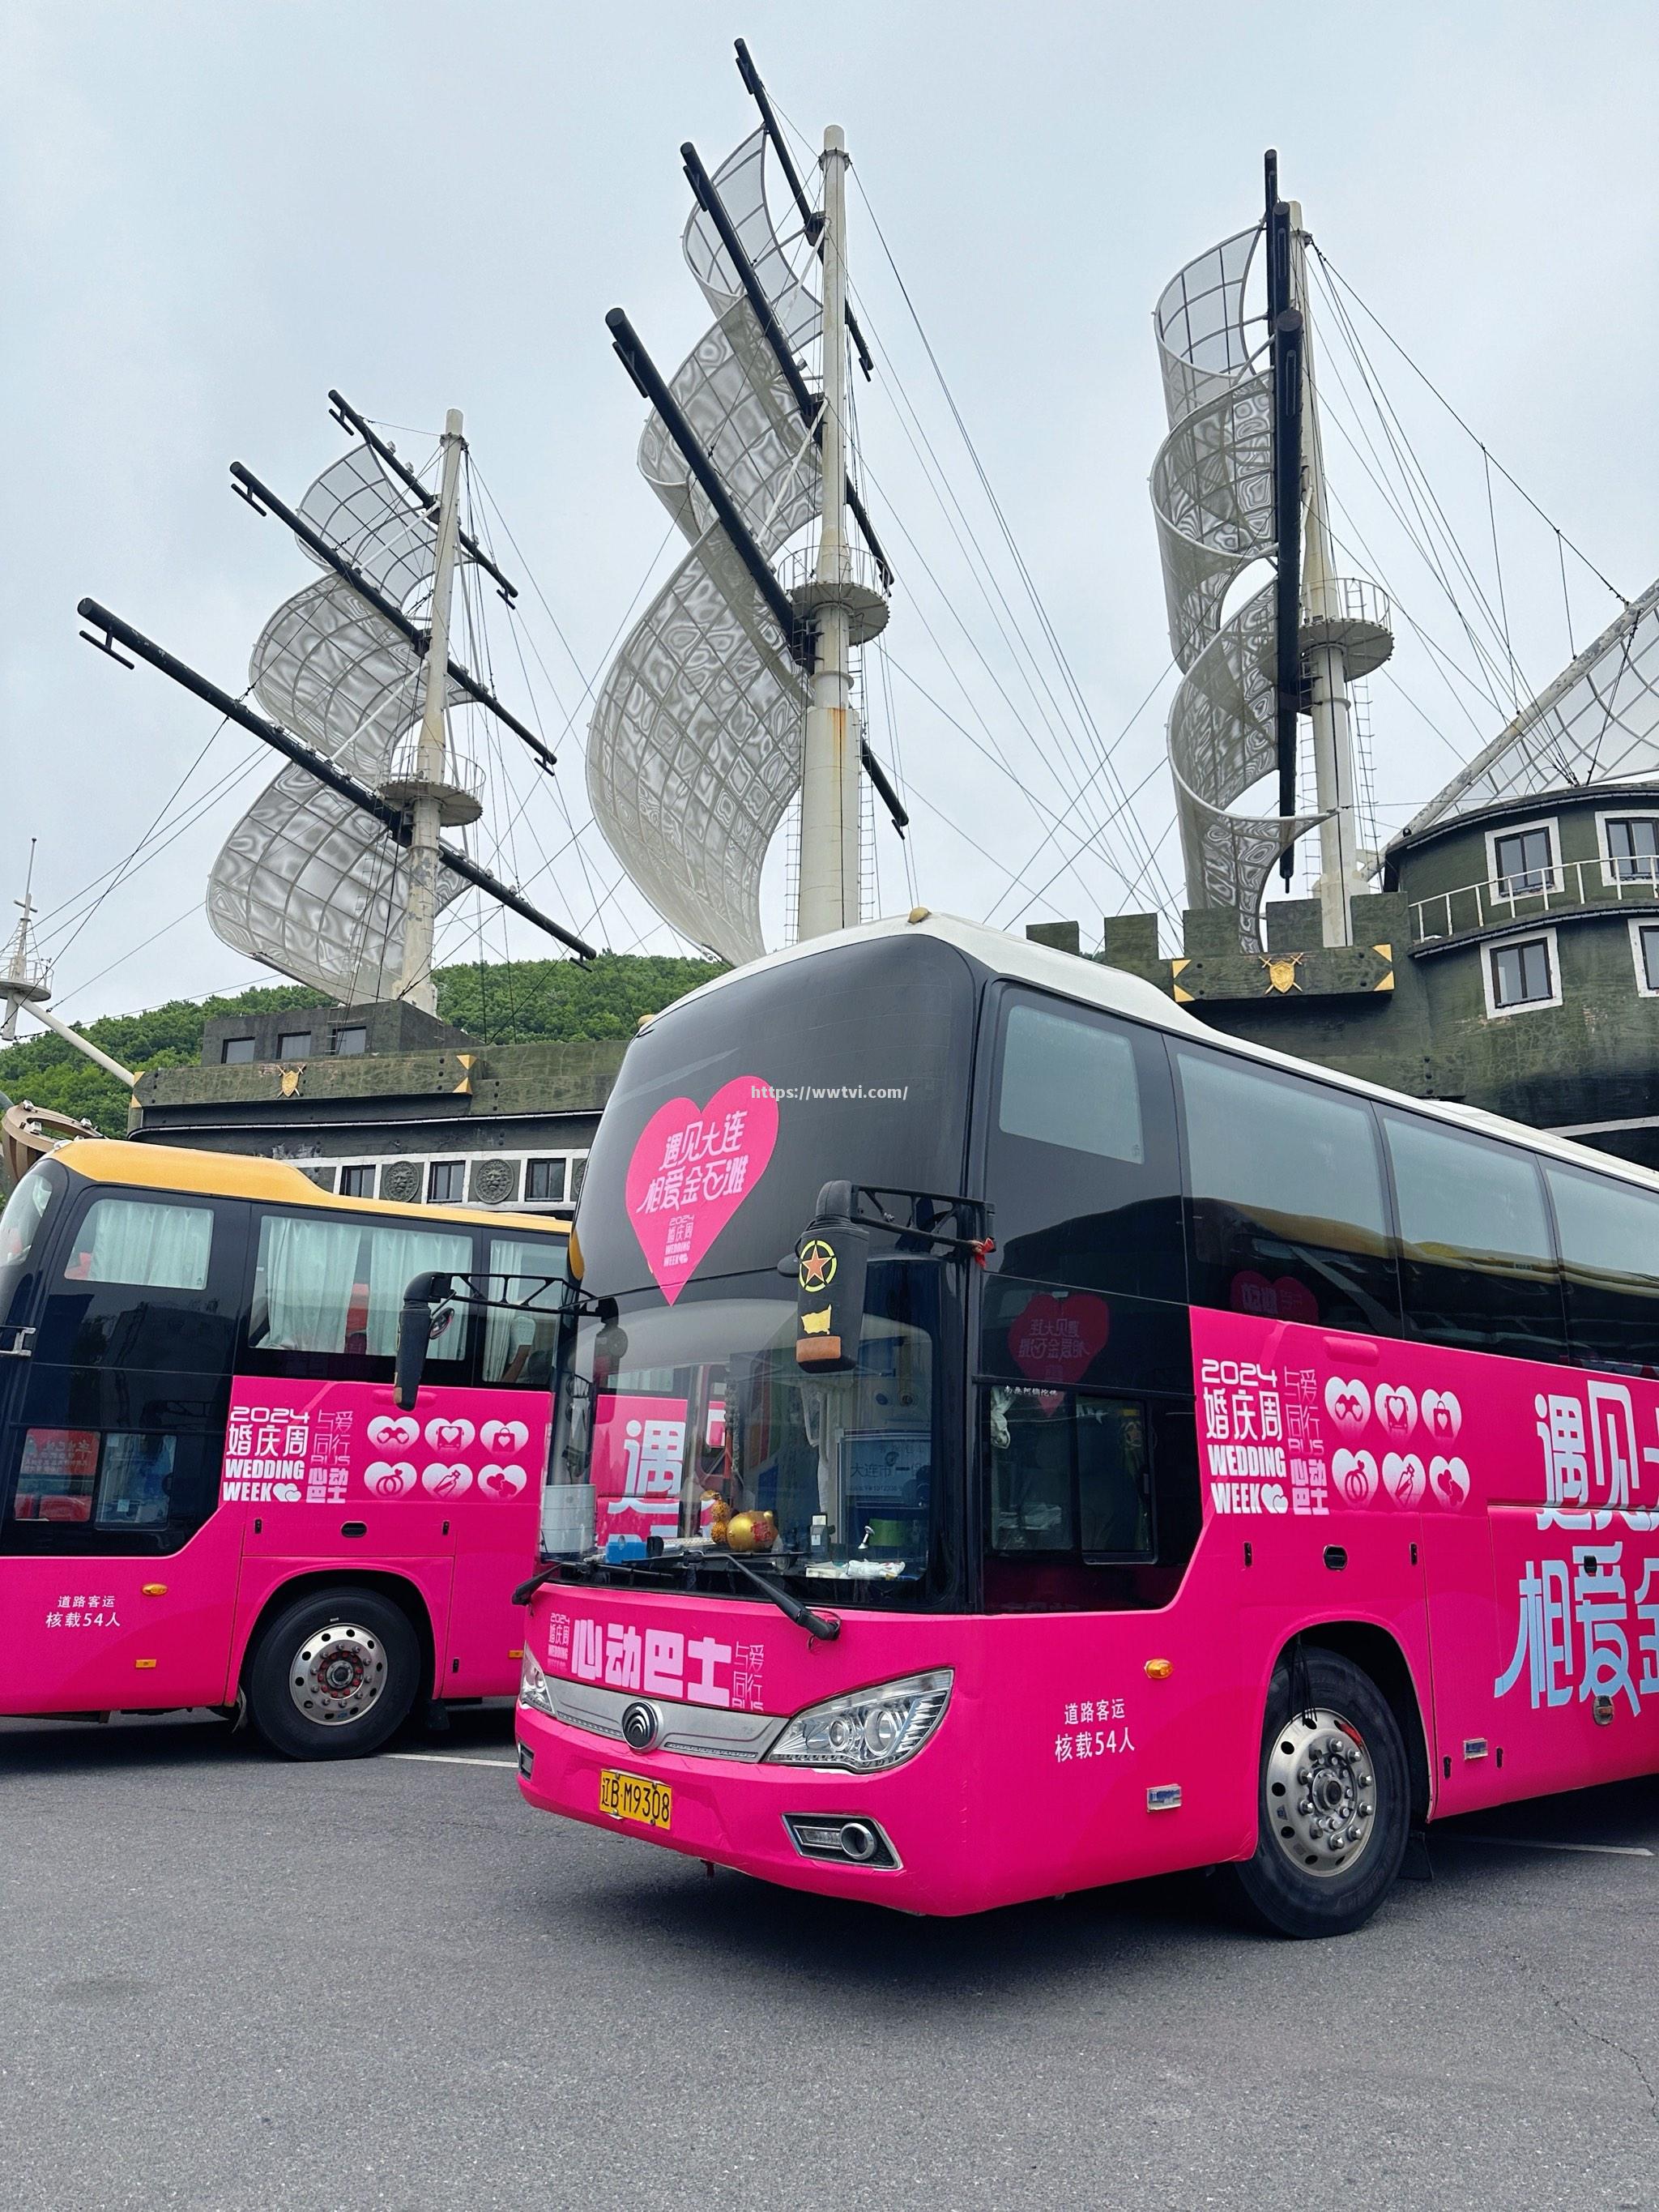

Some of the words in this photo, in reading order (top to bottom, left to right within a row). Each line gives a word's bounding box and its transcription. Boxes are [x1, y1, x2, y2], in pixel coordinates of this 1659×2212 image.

[659, 1110, 748, 1171] 遇见大连
[636, 1155, 749, 1214] 相爱金石滩
[667, 1222, 693, 1244] 婚庆周
[669, 1215, 694, 1226] 2024
[663, 1256, 680, 1267] WEEK
[665, 1241, 691, 1255] WEDDING
[1201, 1359, 1277, 1387] 2024
[1284, 1365, 1318, 1406] 与爱
[230, 1406, 310, 1424] 2024
[316, 1409, 354, 1433] 与爱
[1203, 1387, 1283, 1441] 婚庆周
[1286, 1403, 1320, 1441] 同行
[226, 1424, 309, 1457] 婚庆周
[313, 1433, 351, 1457] 同行
[1287, 1437, 1324, 1456] BUS
[310, 1454, 350, 1466] BUS
[1207, 1444, 1287, 1478] WEDDING
[1535, 1380, 1659, 1531] 遇见
[225, 1459, 305, 1480] WEDDING
[308, 1467, 349, 1485] 心动
[1290, 1458, 1328, 1487] 心动
[223, 1482, 273, 1502] WEEK
[306, 1485, 347, 1504] 巴士
[1210, 1482, 1263, 1514] WEEK
[1292, 1487, 1330, 1516] 巴士
[58, 1595, 116, 1608] 道路客运
[45, 1612, 121, 1629] 核载54人
[551, 1612, 570, 1625] 2024
[571, 1619, 732, 1707] 心动巴士
[734, 1641, 765, 1673] 与爱
[732, 1671, 763, 1703] 同行
[1064, 1698, 1125, 1725] 道路客运
[1055, 1727, 1136, 1763] 核载54人
